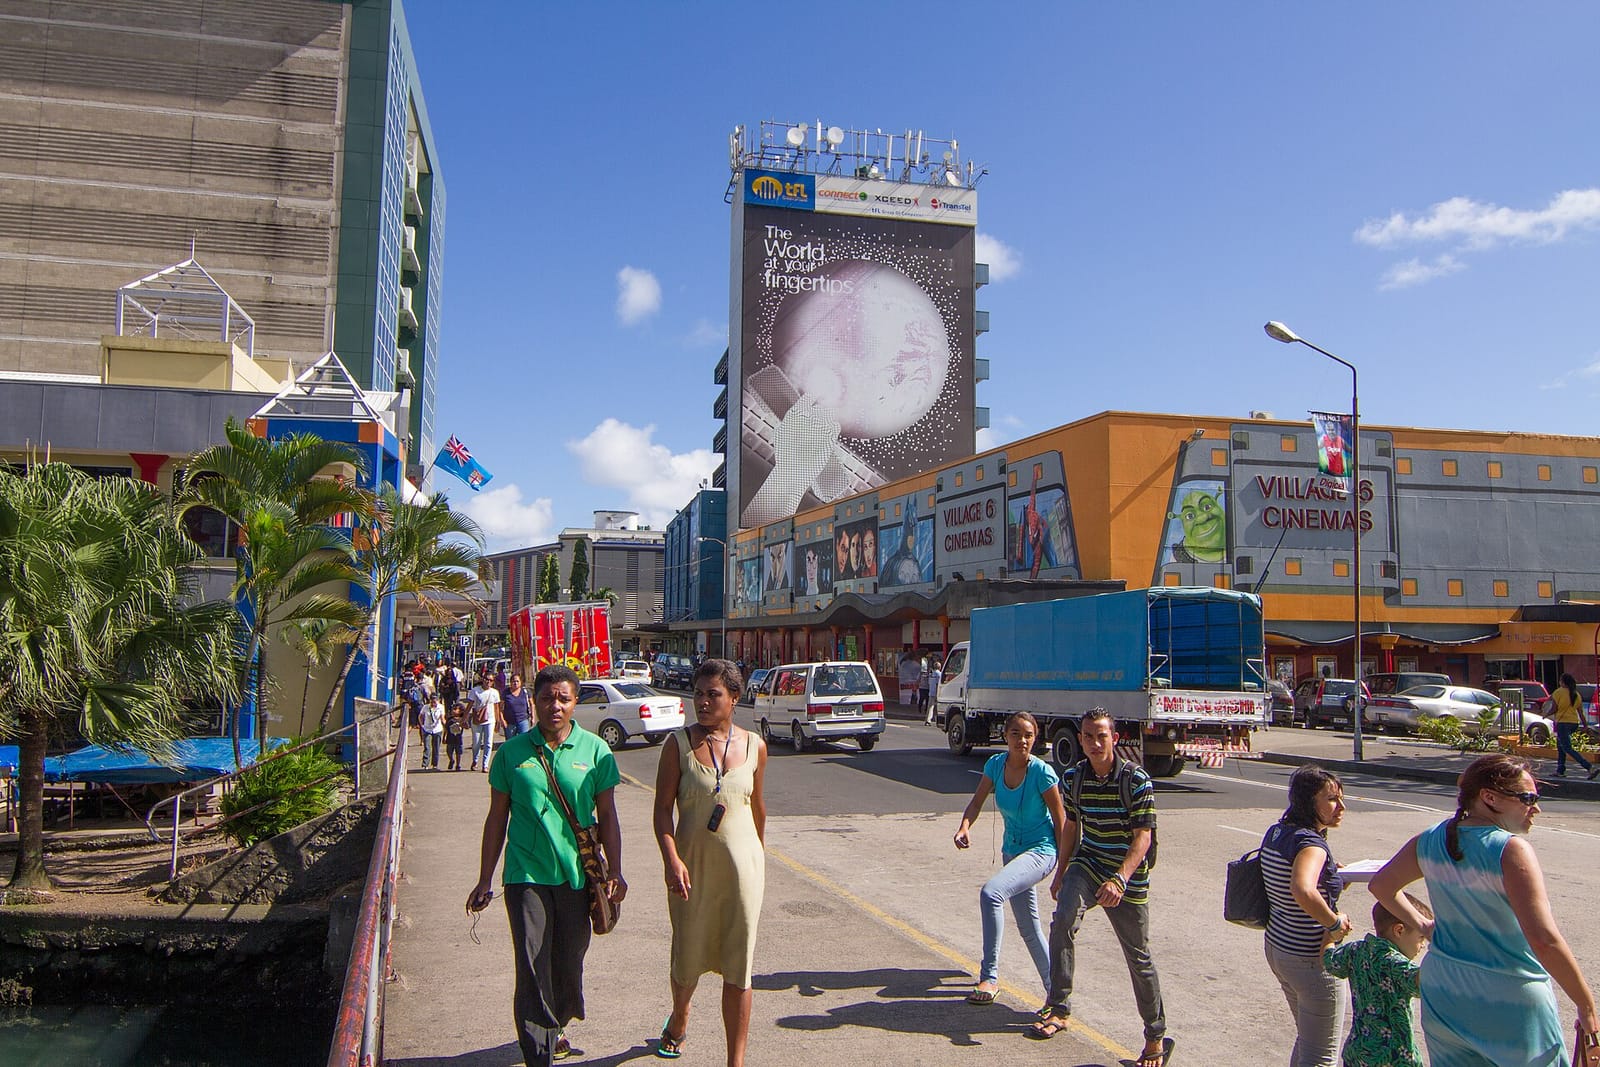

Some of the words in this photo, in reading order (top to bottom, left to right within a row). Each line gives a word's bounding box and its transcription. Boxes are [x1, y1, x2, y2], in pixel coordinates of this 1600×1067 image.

[818, 188, 859, 201] connect
[764, 225, 793, 240] The
[763, 239, 825, 260] World
[763, 256, 778, 270] at
[784, 259, 817, 273] your
[764, 268, 855, 297] fingertips
[1359, 479, 1374, 502] 6
[943, 501, 982, 528] VILLAGE
[985, 498, 996, 519] 6
[1262, 505, 1374, 532] CINEMAS
[944, 526, 994, 552] CINEMAS
